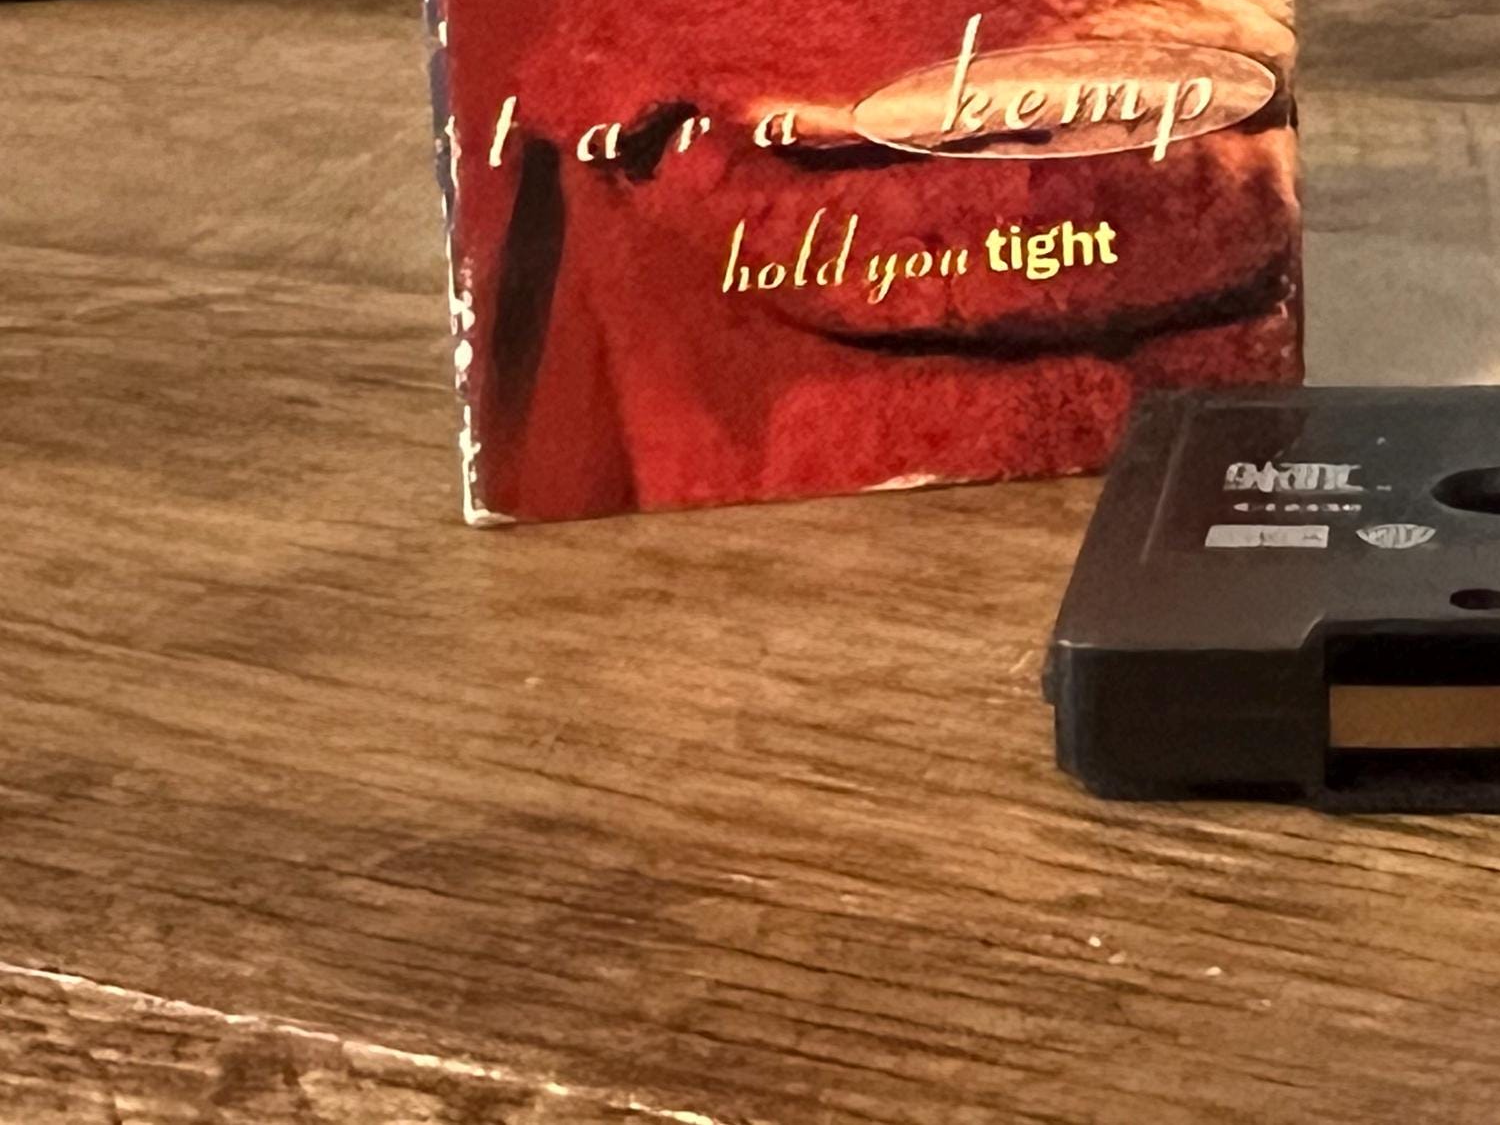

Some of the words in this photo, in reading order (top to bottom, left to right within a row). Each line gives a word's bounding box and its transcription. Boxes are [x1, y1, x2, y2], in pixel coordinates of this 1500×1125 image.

[486, 95, 798, 167] tara
[937, 13, 1213, 162] kemp
[720, 207, 859, 294] hold
[867, 245, 967, 305] you
[984, 220, 1118, 280] tight
